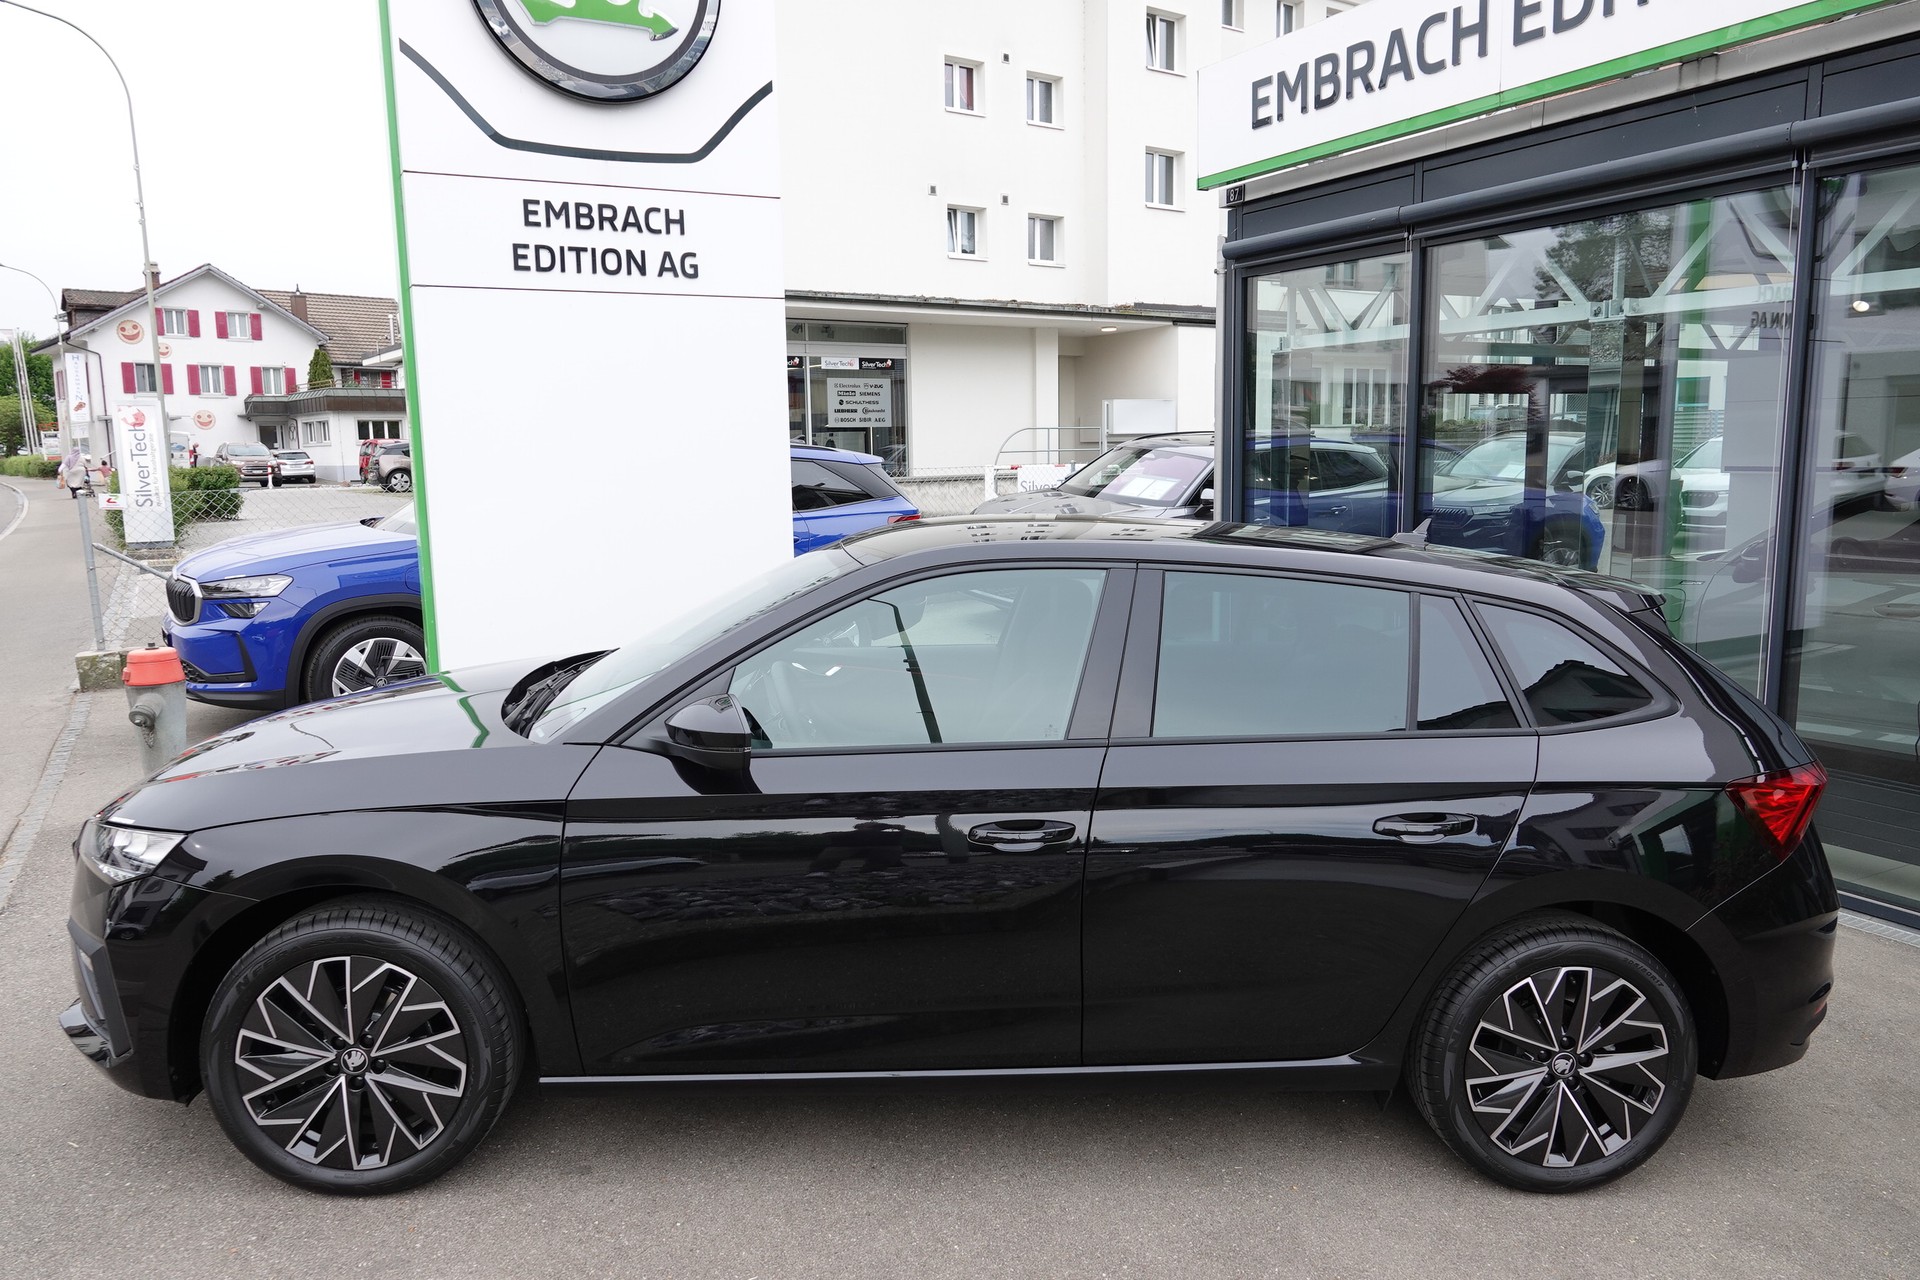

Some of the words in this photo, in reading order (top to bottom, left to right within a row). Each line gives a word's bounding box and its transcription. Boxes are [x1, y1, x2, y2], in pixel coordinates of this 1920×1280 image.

[1252, 0, 1488, 130] EMBRACH
[1229, 187, 1240, 202] 87
[523, 199, 685, 236] EMBRACH
[512, 243, 647, 277] EDITION
[657, 251, 700, 279] AG
